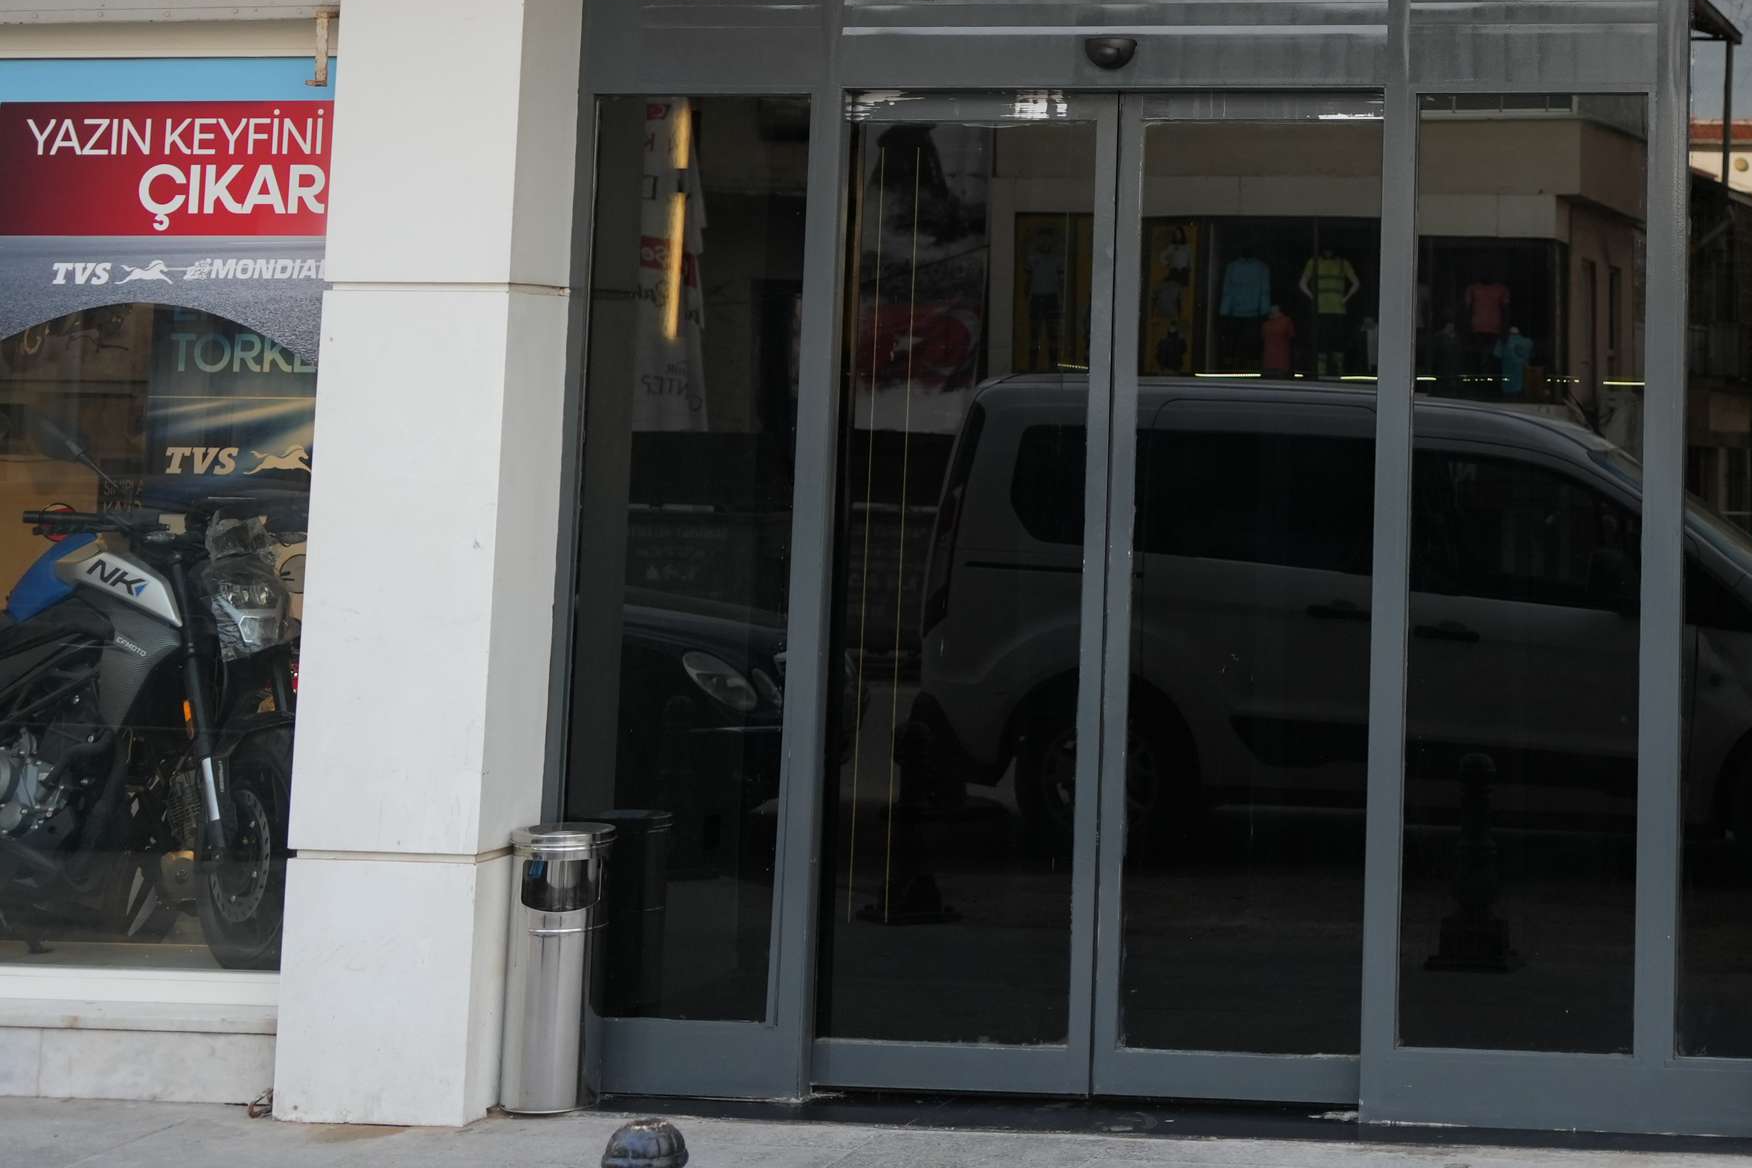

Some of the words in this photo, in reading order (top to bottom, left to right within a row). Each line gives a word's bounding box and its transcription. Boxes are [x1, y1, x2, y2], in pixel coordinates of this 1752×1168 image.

[27, 118, 152, 156] YAZIN
[164, 108, 325, 156] KEYFİNİ
[139, 164, 326, 231] ÇIKAR
[52, 262, 112, 285] TVS
[165, 447, 239, 475] TVS
[86, 559, 146, 597] NK
